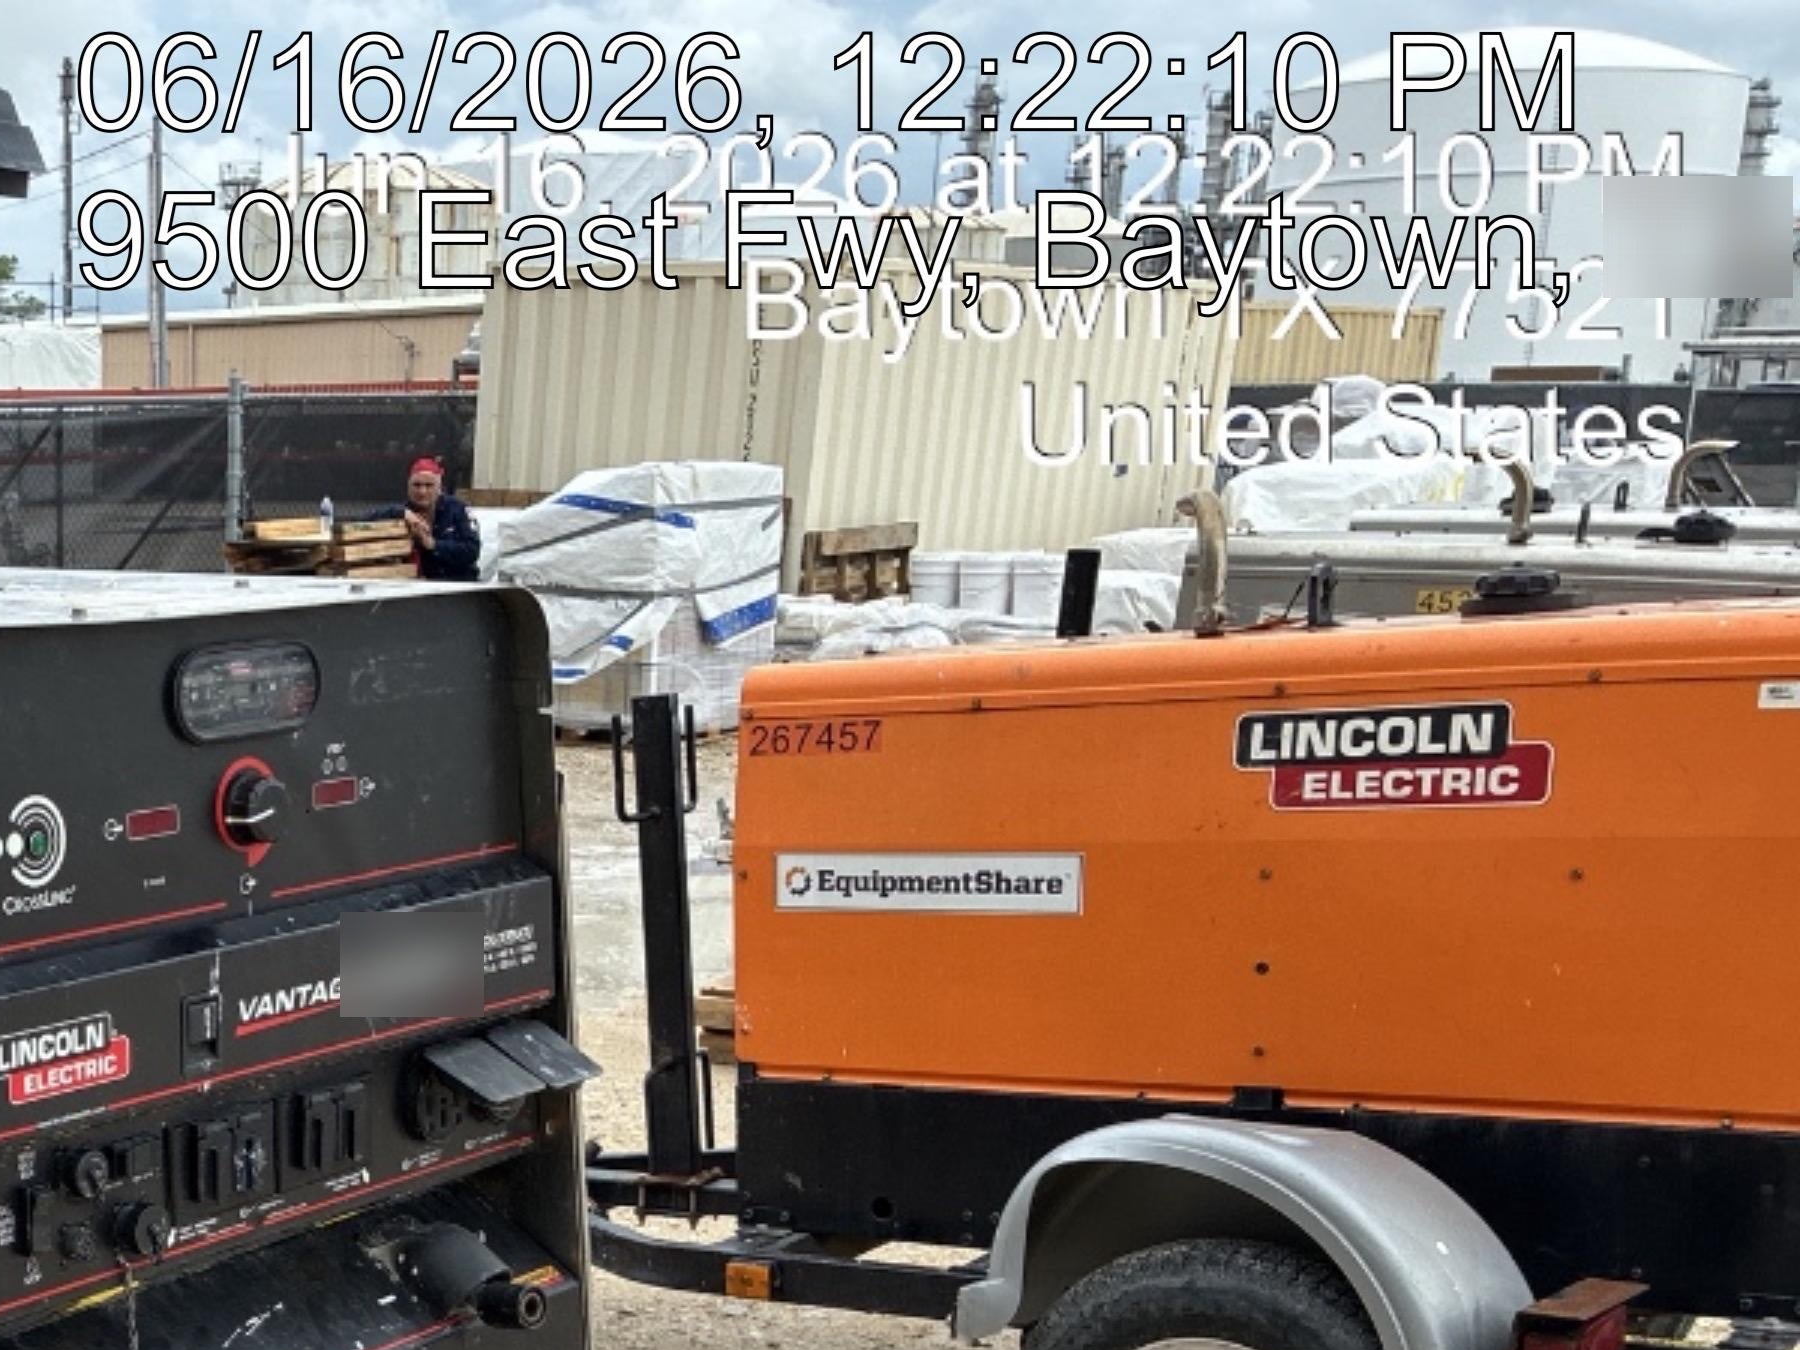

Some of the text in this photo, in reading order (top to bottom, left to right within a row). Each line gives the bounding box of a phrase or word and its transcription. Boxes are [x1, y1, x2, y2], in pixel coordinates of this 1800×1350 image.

[749, 720, 882, 756] 267457
[1250, 712, 1496, 761] LINCOLN
[1302, 765, 1521, 801] ELECTRIC
[816, 868, 1064, 898] EquipmentShare
[238, 976, 340, 1022] VANTAG
[22, 1053, 119, 1095] ELECTRIC
